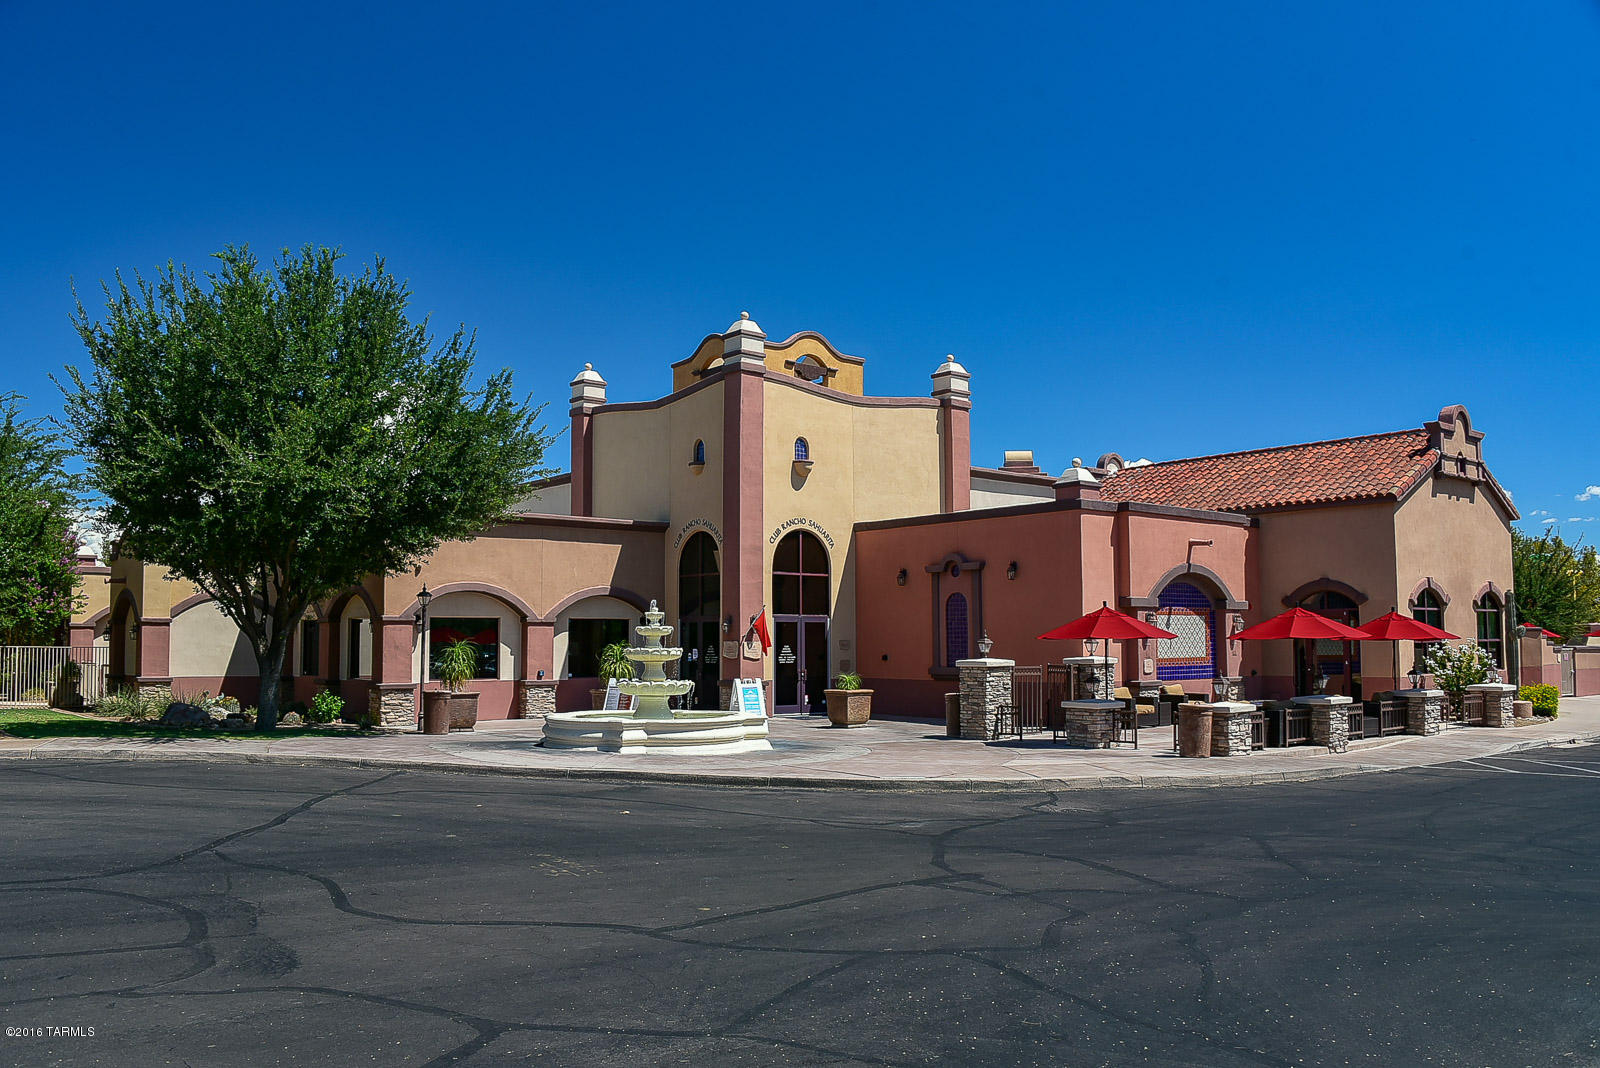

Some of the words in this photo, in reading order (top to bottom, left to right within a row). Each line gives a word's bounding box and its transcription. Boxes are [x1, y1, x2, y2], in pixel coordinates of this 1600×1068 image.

[769, 528, 782, 544] CLUB
[781, 517, 806, 530] RANCHO
[808, 520, 835, 549] SAHUARITA
